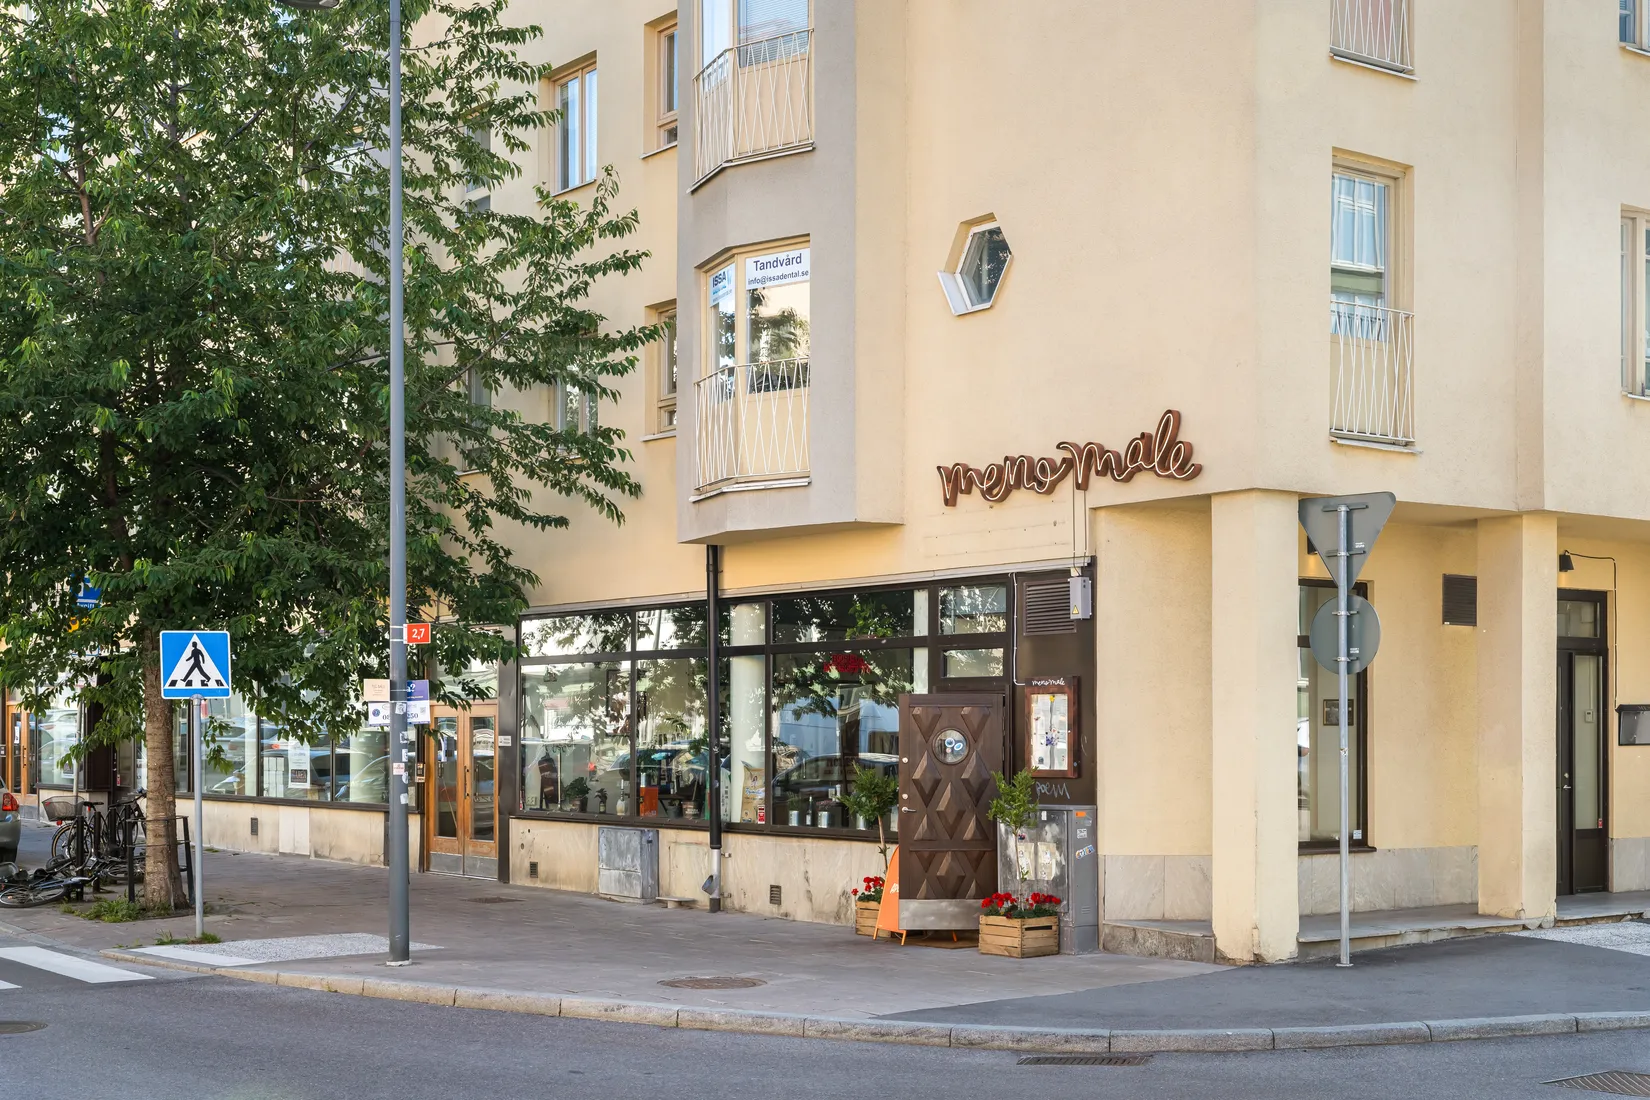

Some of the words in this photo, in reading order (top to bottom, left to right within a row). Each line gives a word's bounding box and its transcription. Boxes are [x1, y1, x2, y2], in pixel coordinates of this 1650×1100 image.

[753, 253, 802, 272] Tandvård
[712, 271, 727, 288] ISSA
[748, 270, 809, 285] info@issadental.se
[412, 628, 425, 640] 2,7
